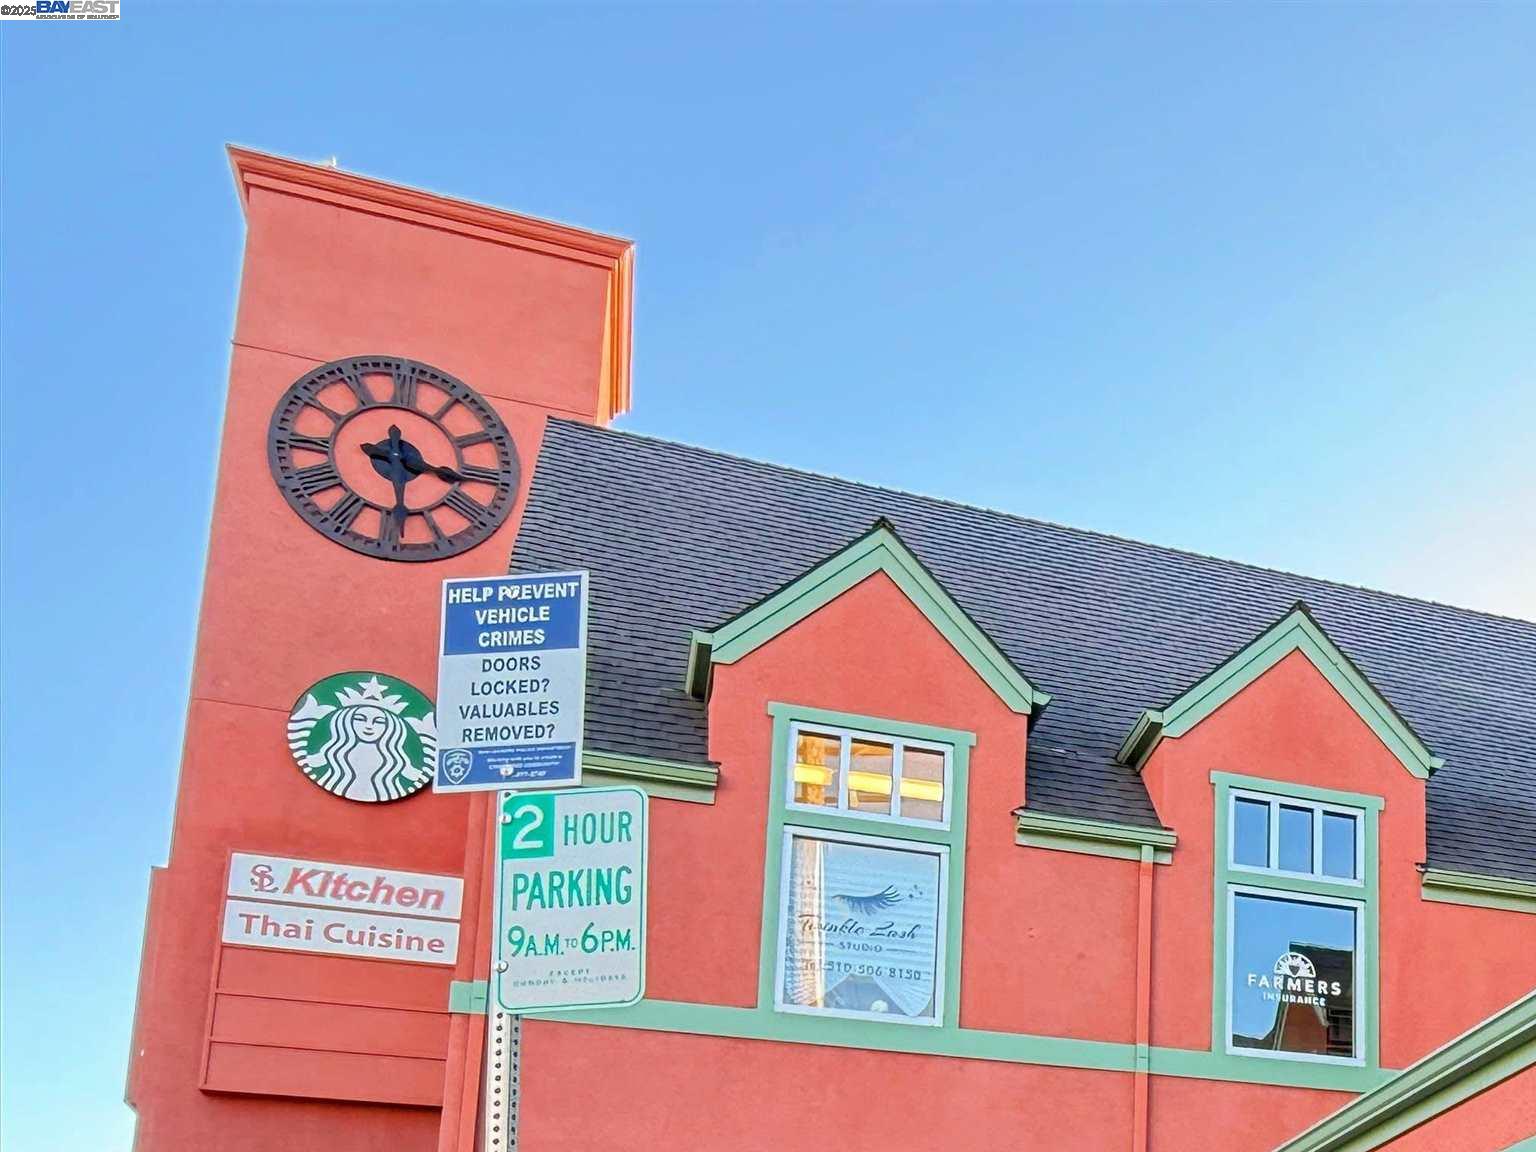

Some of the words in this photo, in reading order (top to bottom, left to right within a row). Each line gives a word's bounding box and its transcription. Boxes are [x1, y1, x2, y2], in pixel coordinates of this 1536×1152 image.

[449, 586, 494, 604] HELP
[475, 606, 550, 625] VEHICLE
[478, 628, 545, 647] CRIMES
[482, 656, 541, 672] DOORS
[471, 678, 550, 696] LOCKED?
[459, 700, 560, 720] VALUABLES
[462, 723, 555, 743] REMOVED?
[512, 804, 544, 850] 2
[563, 811, 632, 846] HOUR
[512, 865, 632, 911] PARKING
[239, 912, 314, 941] Thai
[323, 922, 446, 953] Cuisine
[839, 941, 883, 953] STUDIO
[1247, 973, 1342, 996] FARMERS
[1263, 991, 1327, 1007] INSURANCE
